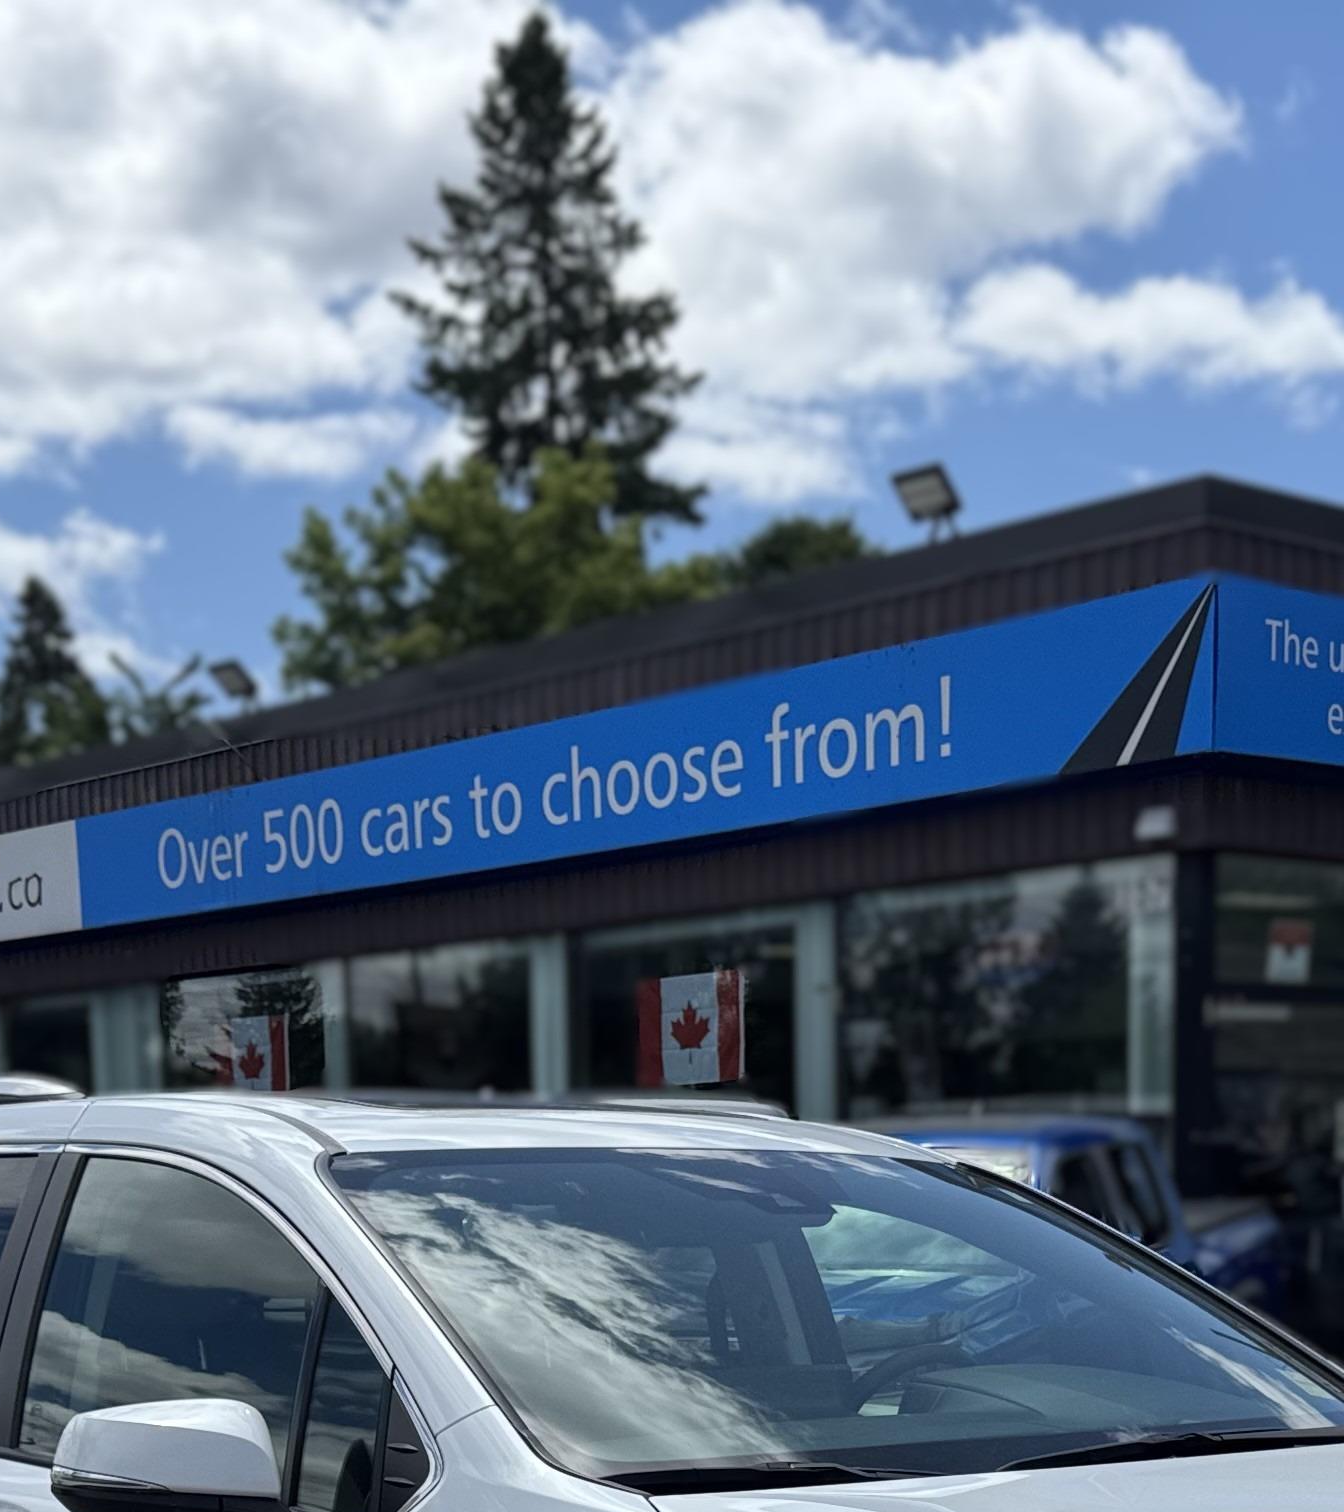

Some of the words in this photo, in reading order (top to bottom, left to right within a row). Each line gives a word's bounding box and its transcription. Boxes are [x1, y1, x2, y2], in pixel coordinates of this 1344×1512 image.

[1265, 618, 1319, 669] The
[158, 828, 248, 889] Over
[263, 799, 344, 873] 500
[361, 795, 453, 857] cars
[469, 774, 522, 839] to
[542, 739, 743, 825] choose
[765, 675, 952, 789] from!
